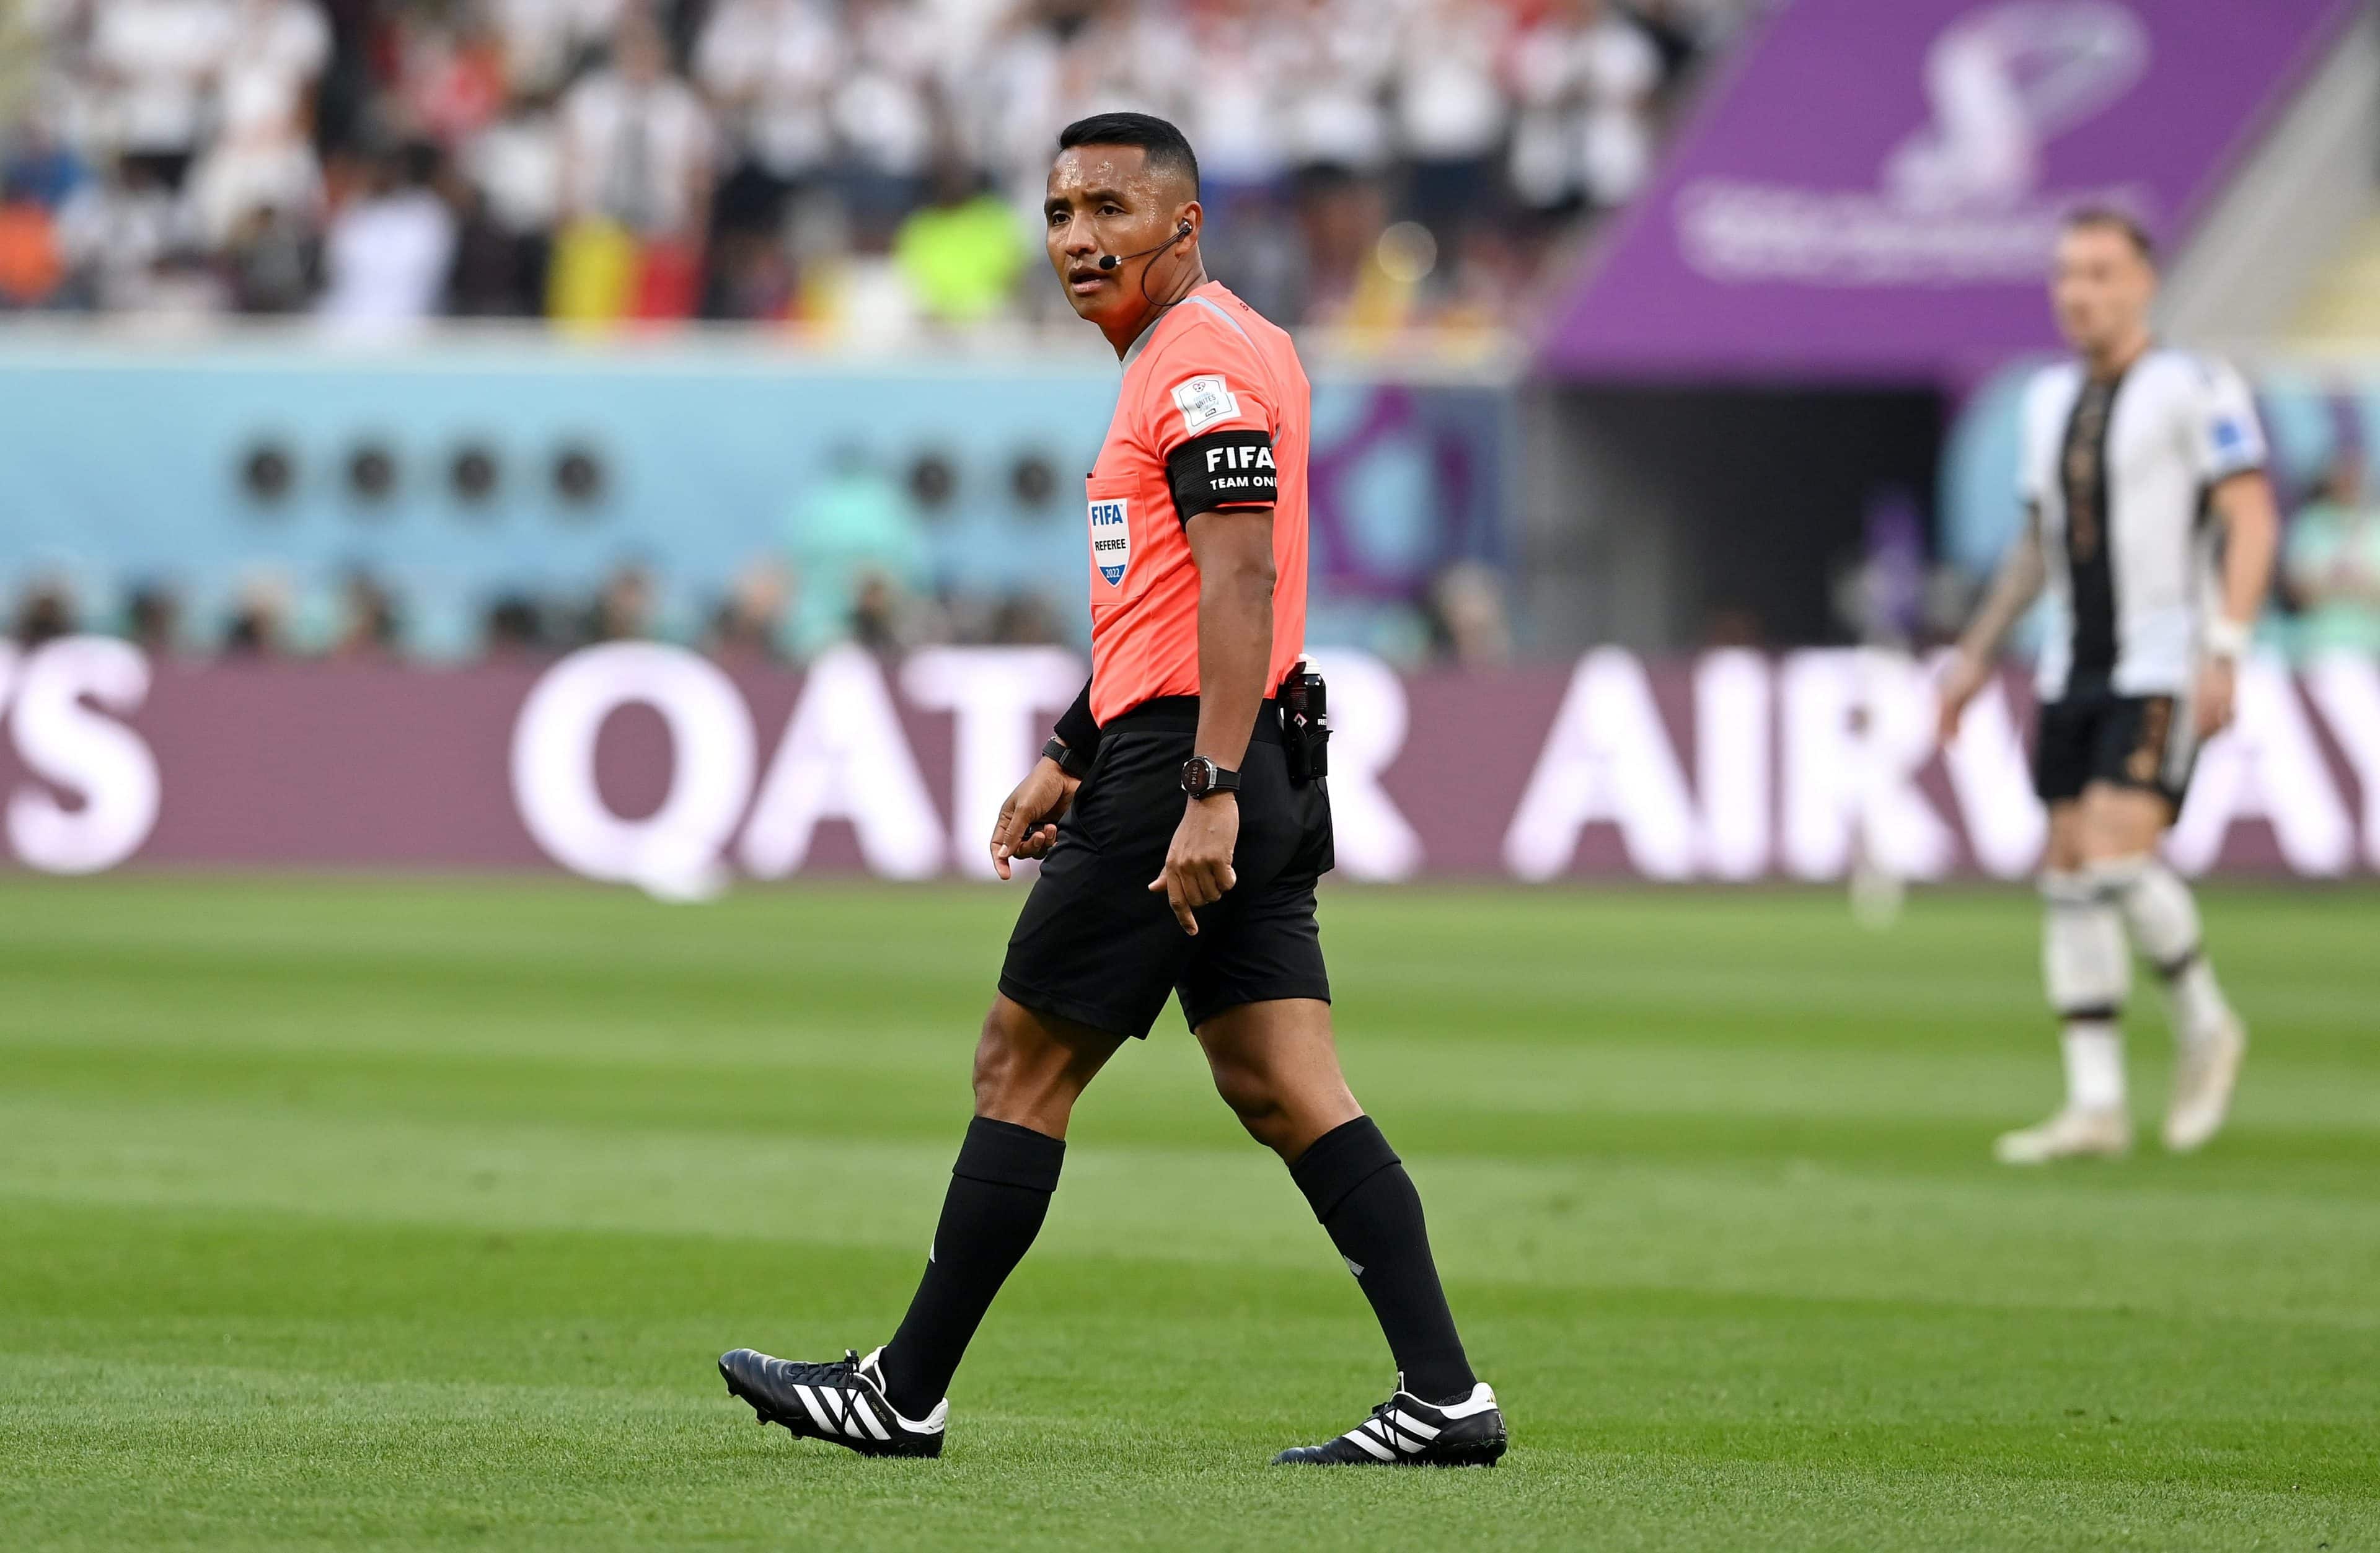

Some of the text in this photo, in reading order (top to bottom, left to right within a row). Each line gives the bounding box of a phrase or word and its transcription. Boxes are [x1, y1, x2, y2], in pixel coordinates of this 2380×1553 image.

[1195, 394, 1216, 409] UNITES
[1206, 446, 1276, 472] FIFA
[1209, 477, 1249, 490] TEAM
[1091, 504, 1123, 526] FIFA
[1095, 539, 1126, 551] REFEREE
[1105, 568, 1120, 578] 2022
[511, 638, 1427, 902] QATR
